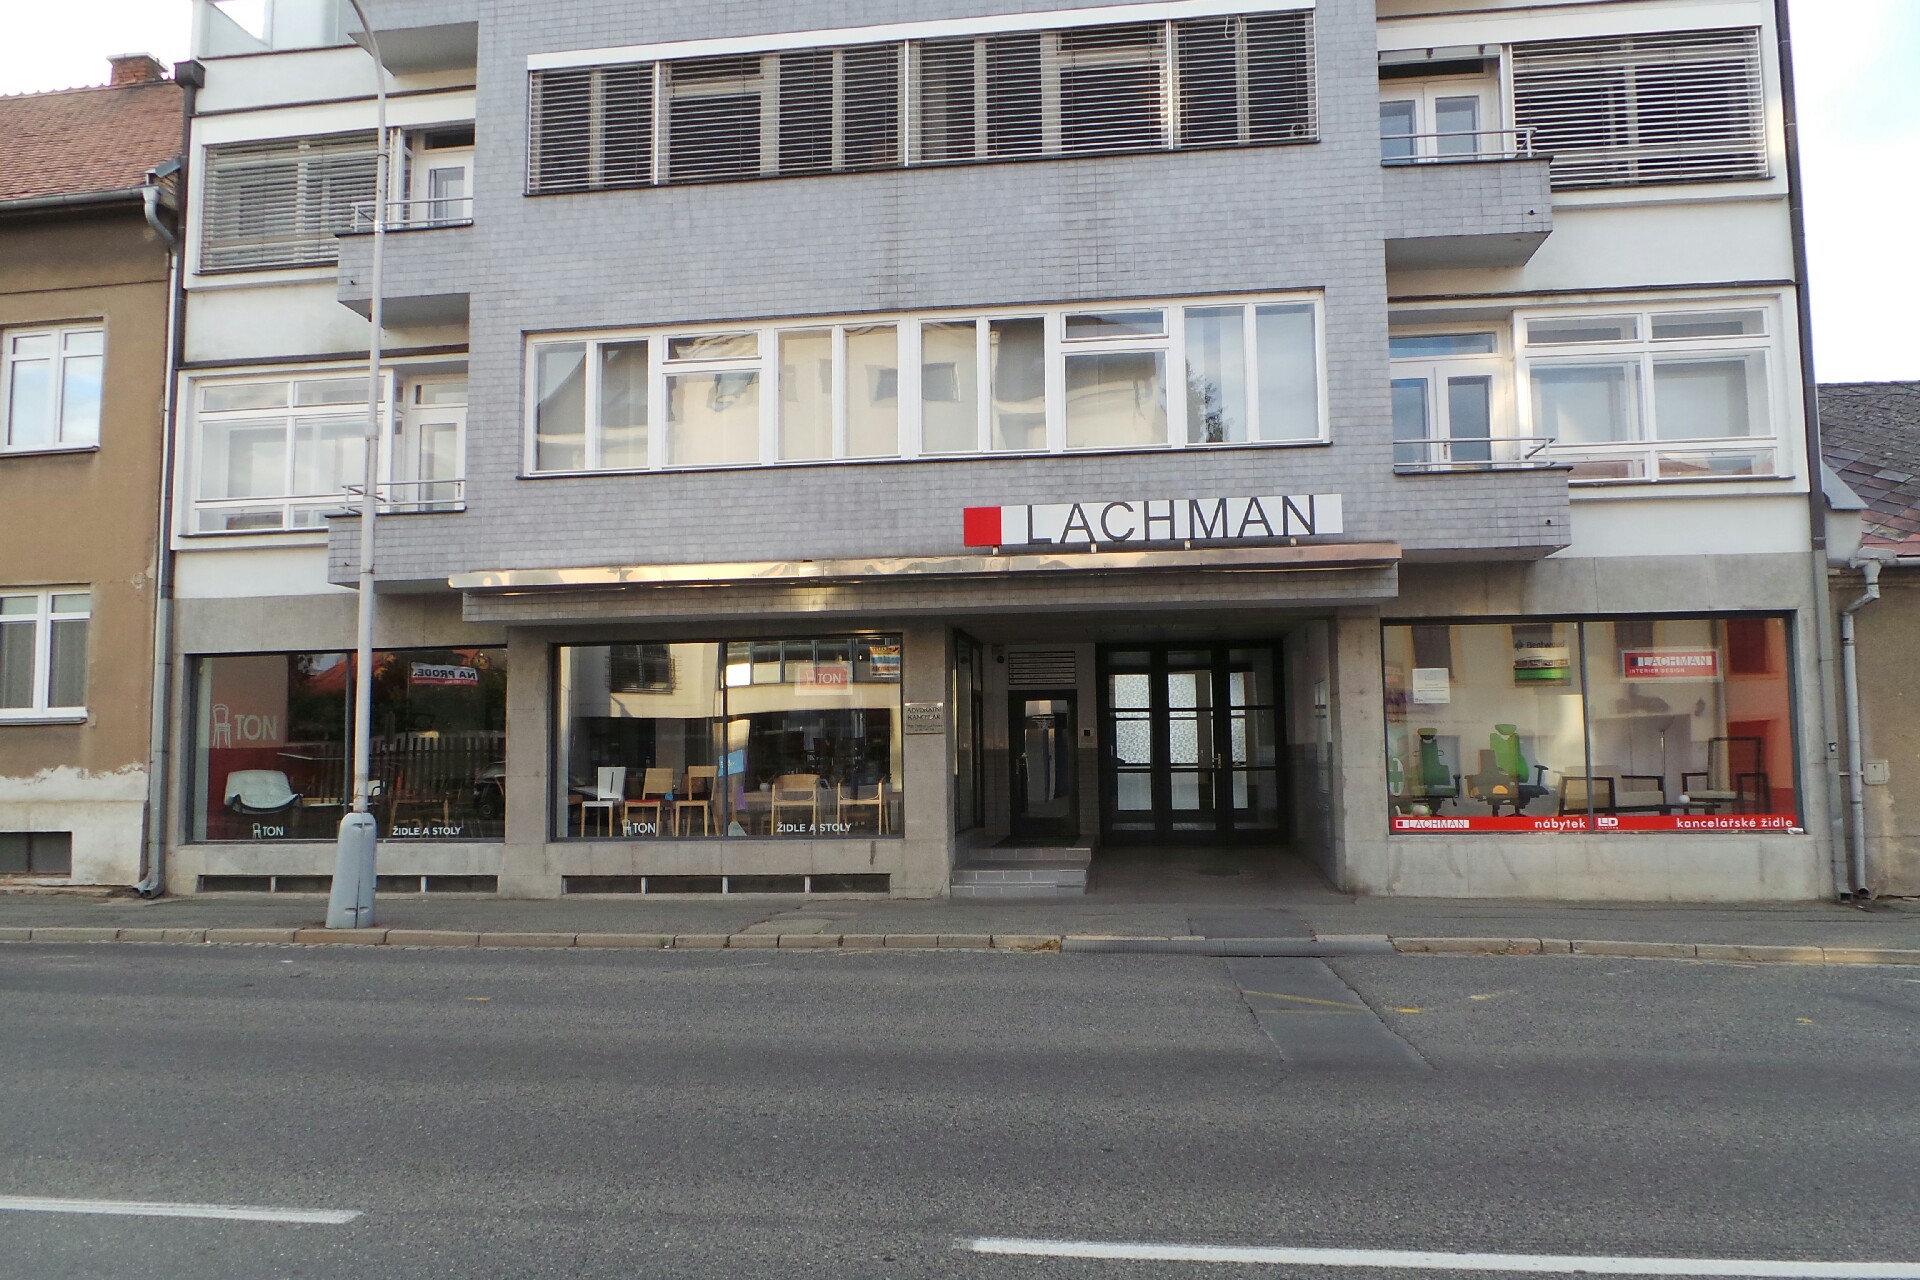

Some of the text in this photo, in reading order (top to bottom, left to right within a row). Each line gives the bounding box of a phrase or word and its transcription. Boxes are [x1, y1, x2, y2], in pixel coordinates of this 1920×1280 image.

[1027, 494, 1315, 545] LACHMAN
[1643, 656, 1707, 667] LACHMAN
[817, 673, 841, 684] TON
[234, 714, 279, 740] TON
[632, 822, 656, 834] TON
[776, 821, 852, 832] ŽIDLE A STOLY
[1409, 820, 1465, 829] LACHMAN
[1534, 817, 1586, 830] nábytek
[1676, 817, 1793, 828] kancelářské židle
[262, 826, 284, 836] TON
[392, 825, 462, 836] ŽIDLE A STOLY
